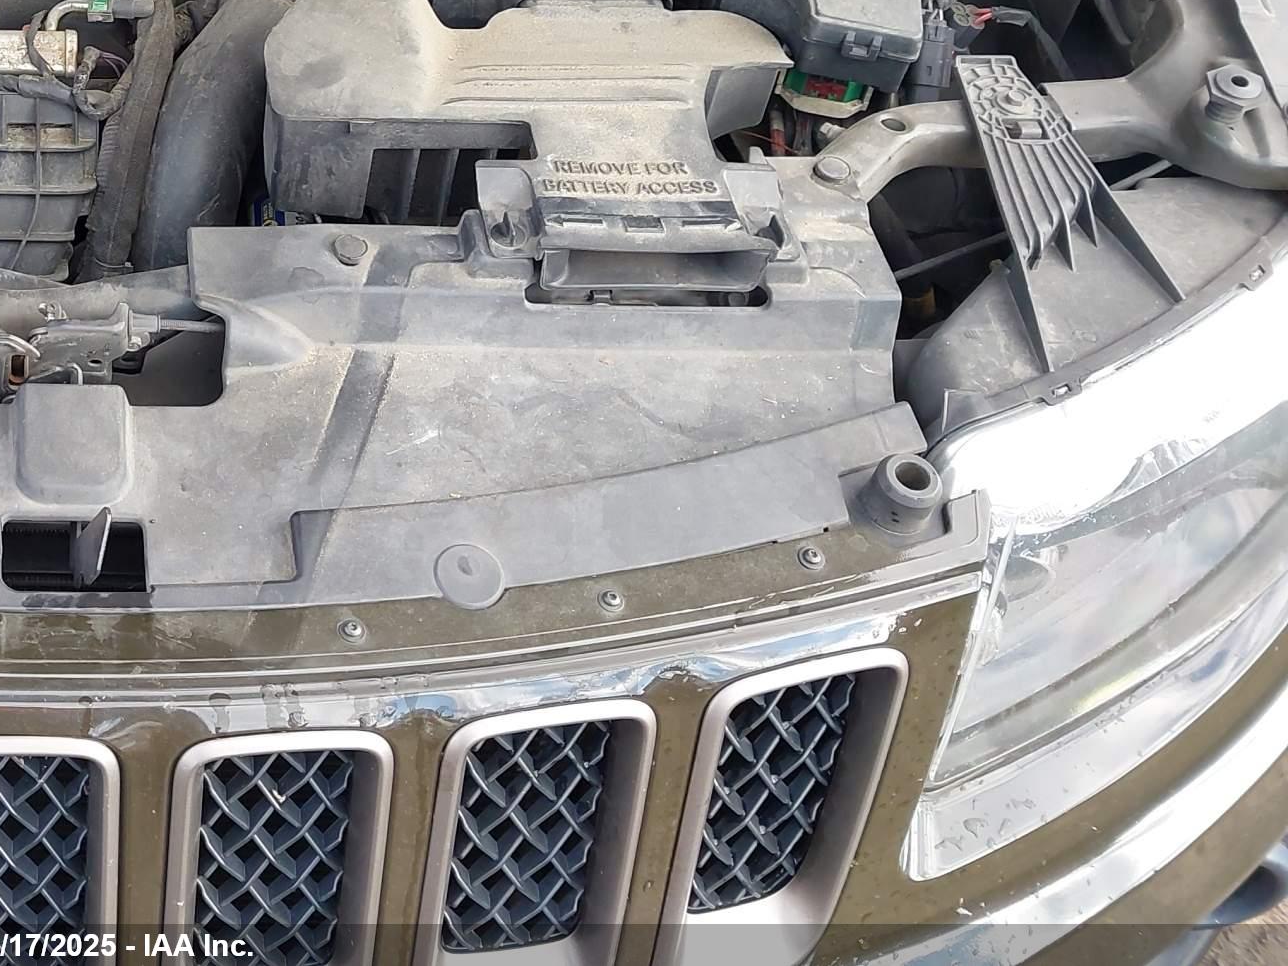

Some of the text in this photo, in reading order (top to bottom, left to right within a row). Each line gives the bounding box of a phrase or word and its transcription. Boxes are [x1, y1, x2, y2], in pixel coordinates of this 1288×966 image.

[552, 160, 688, 176] REMOVE FOR
[542, 178, 718, 195] BATTERY ACCESS
